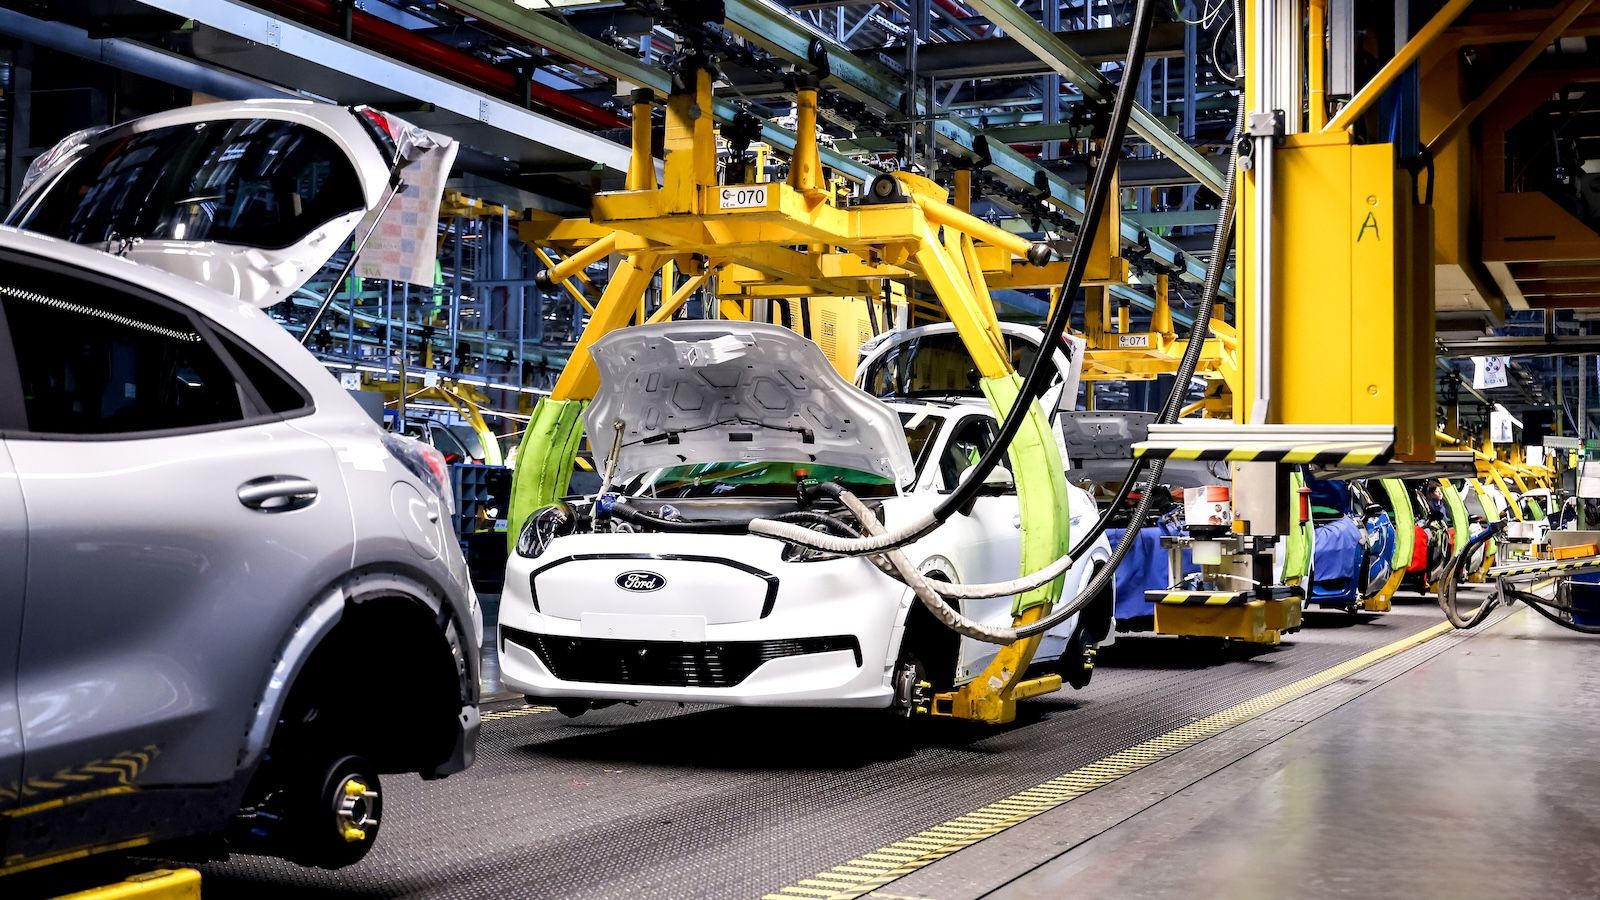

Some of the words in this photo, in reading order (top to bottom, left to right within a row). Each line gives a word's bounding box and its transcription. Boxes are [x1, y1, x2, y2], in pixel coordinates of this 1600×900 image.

[737, 189, 764, 205] 070
[1357, 211, 1380, 242] A
[1129, 336, 1146, 346] 071
[624, 573, 657, 589] Ford
